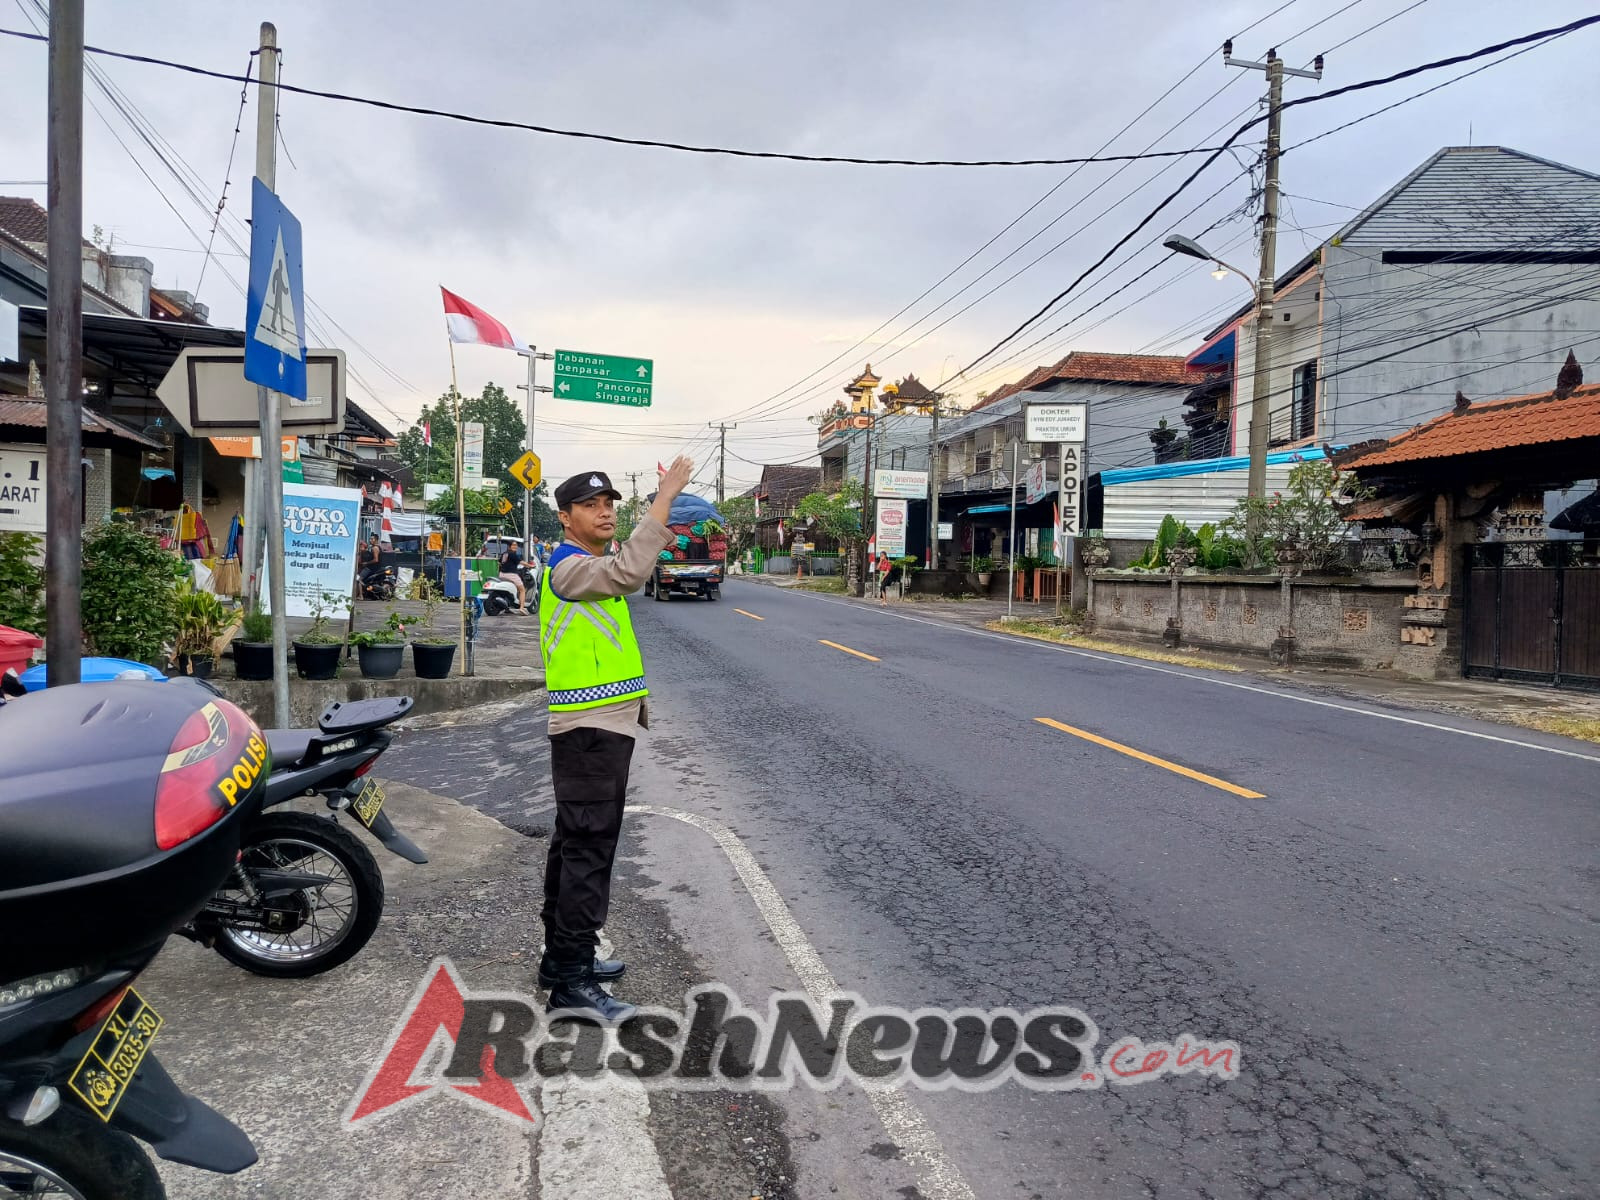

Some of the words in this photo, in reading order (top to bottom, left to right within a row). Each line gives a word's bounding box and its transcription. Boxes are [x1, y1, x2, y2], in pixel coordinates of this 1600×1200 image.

[558, 353, 605, 366] Tabanan
[557, 363, 611, 377] Denpasar
[597, 382, 649, 395] Pancoran
[595, 391, 649, 405] Singaraja
[1063, 448, 1078, 533] APOTEK
[285, 505, 346, 524] TOKO
[291, 540, 330, 550] Menjual
[284, 550, 307, 558] neka
[290, 560, 314, 570] dupa
[316, 562, 330, 570] dll
[217, 731, 267, 807] POLISI
[108, 1014, 128, 1041] XI
[113, 1013, 156, 1079] 3035-30
